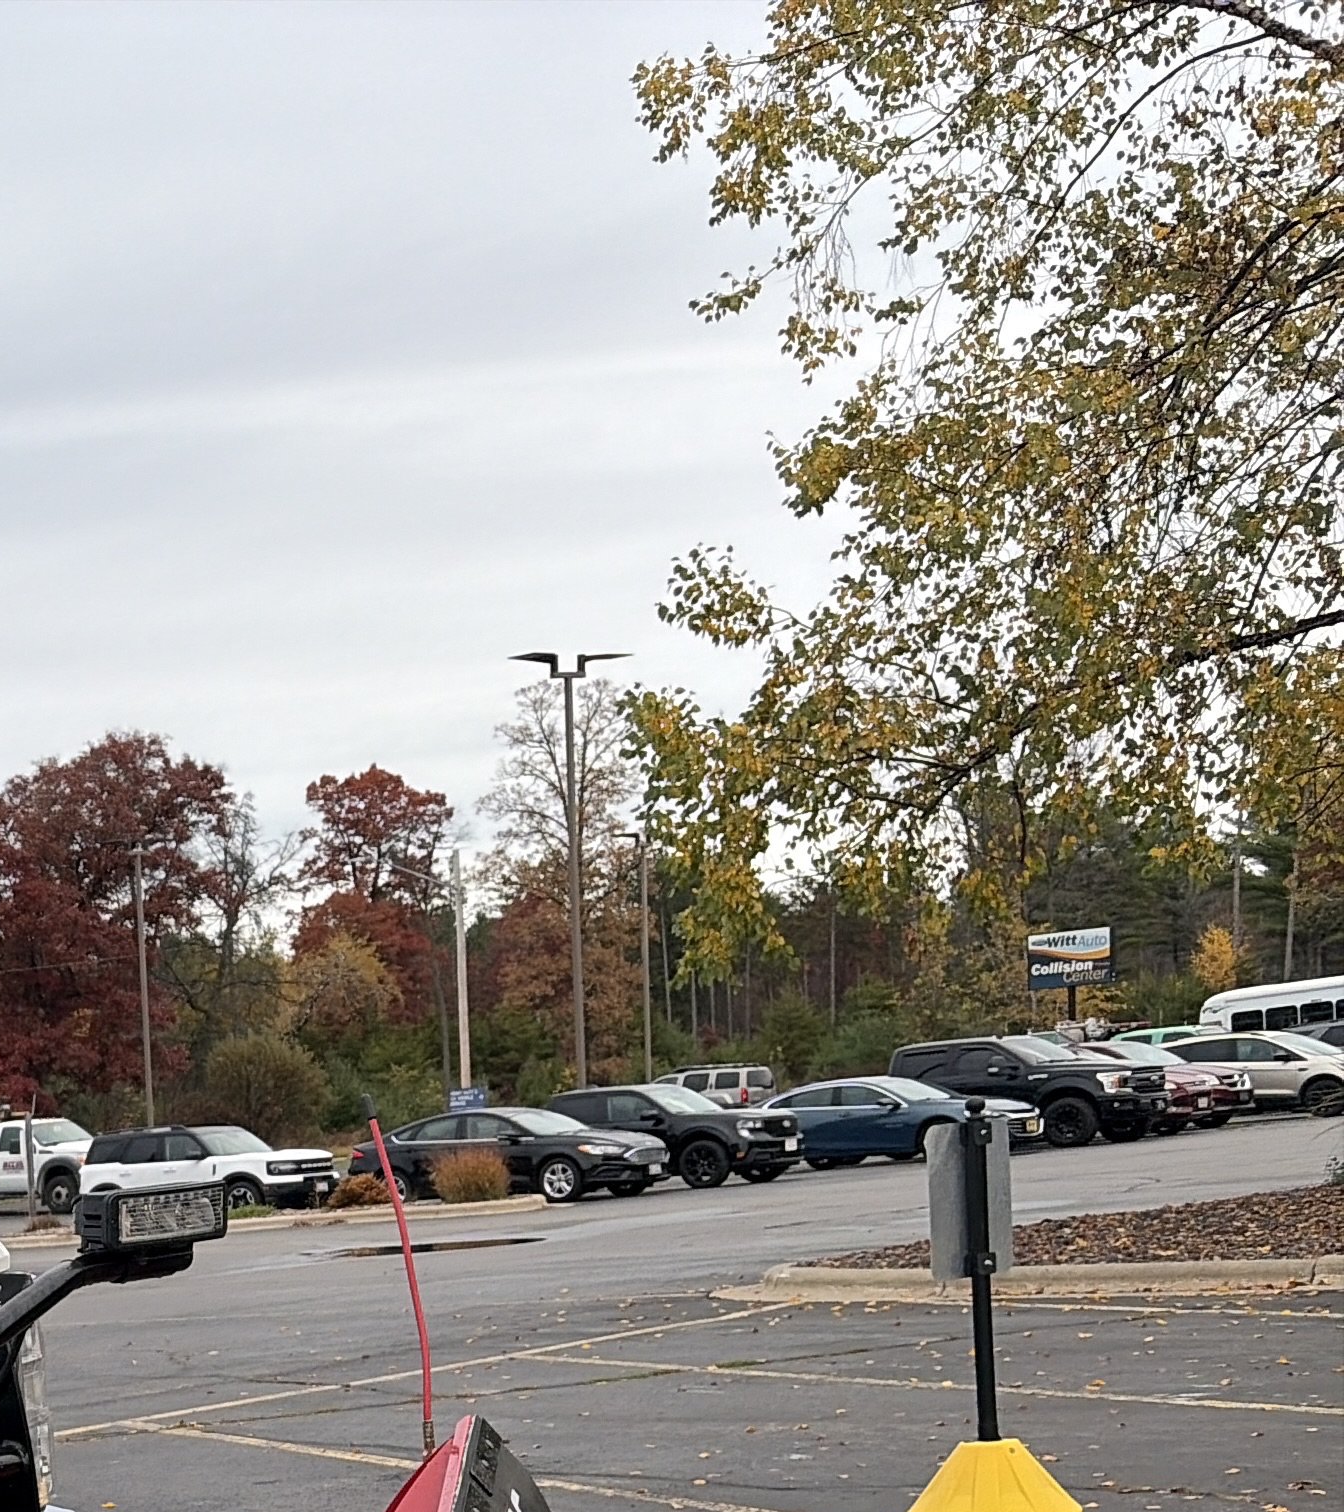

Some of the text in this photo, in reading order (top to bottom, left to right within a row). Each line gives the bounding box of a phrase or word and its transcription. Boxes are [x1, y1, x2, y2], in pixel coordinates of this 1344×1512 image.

[1047, 935, 1077, 948] Witt
[1078, 934, 1107, 947] Auto
[1031, 960, 1093, 976] Collision
[1063, 969, 1109, 983] Center
